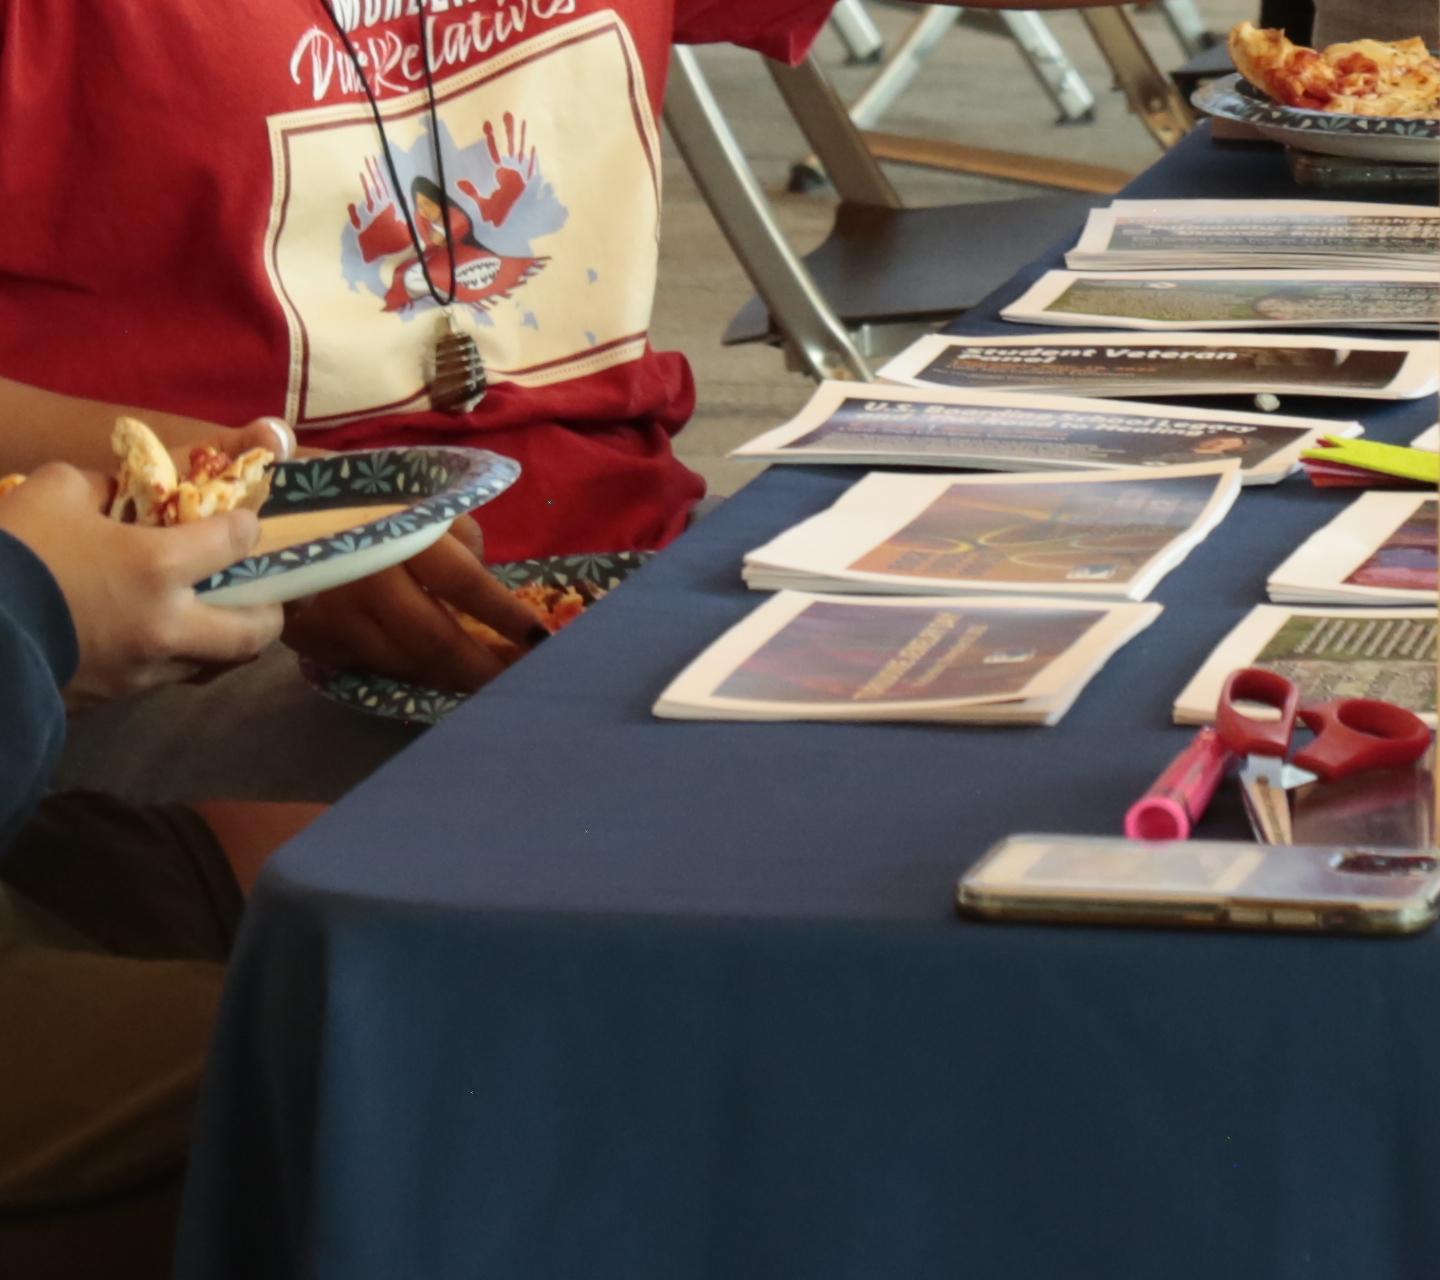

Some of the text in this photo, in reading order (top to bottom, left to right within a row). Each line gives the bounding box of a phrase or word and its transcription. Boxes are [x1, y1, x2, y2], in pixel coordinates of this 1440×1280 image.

[957, 354, 1058, 365] Panel
[960, 347, 1238, 361] Student Veteran
[863, 401, 1258, 435] U.S. Boarding School Legacy
